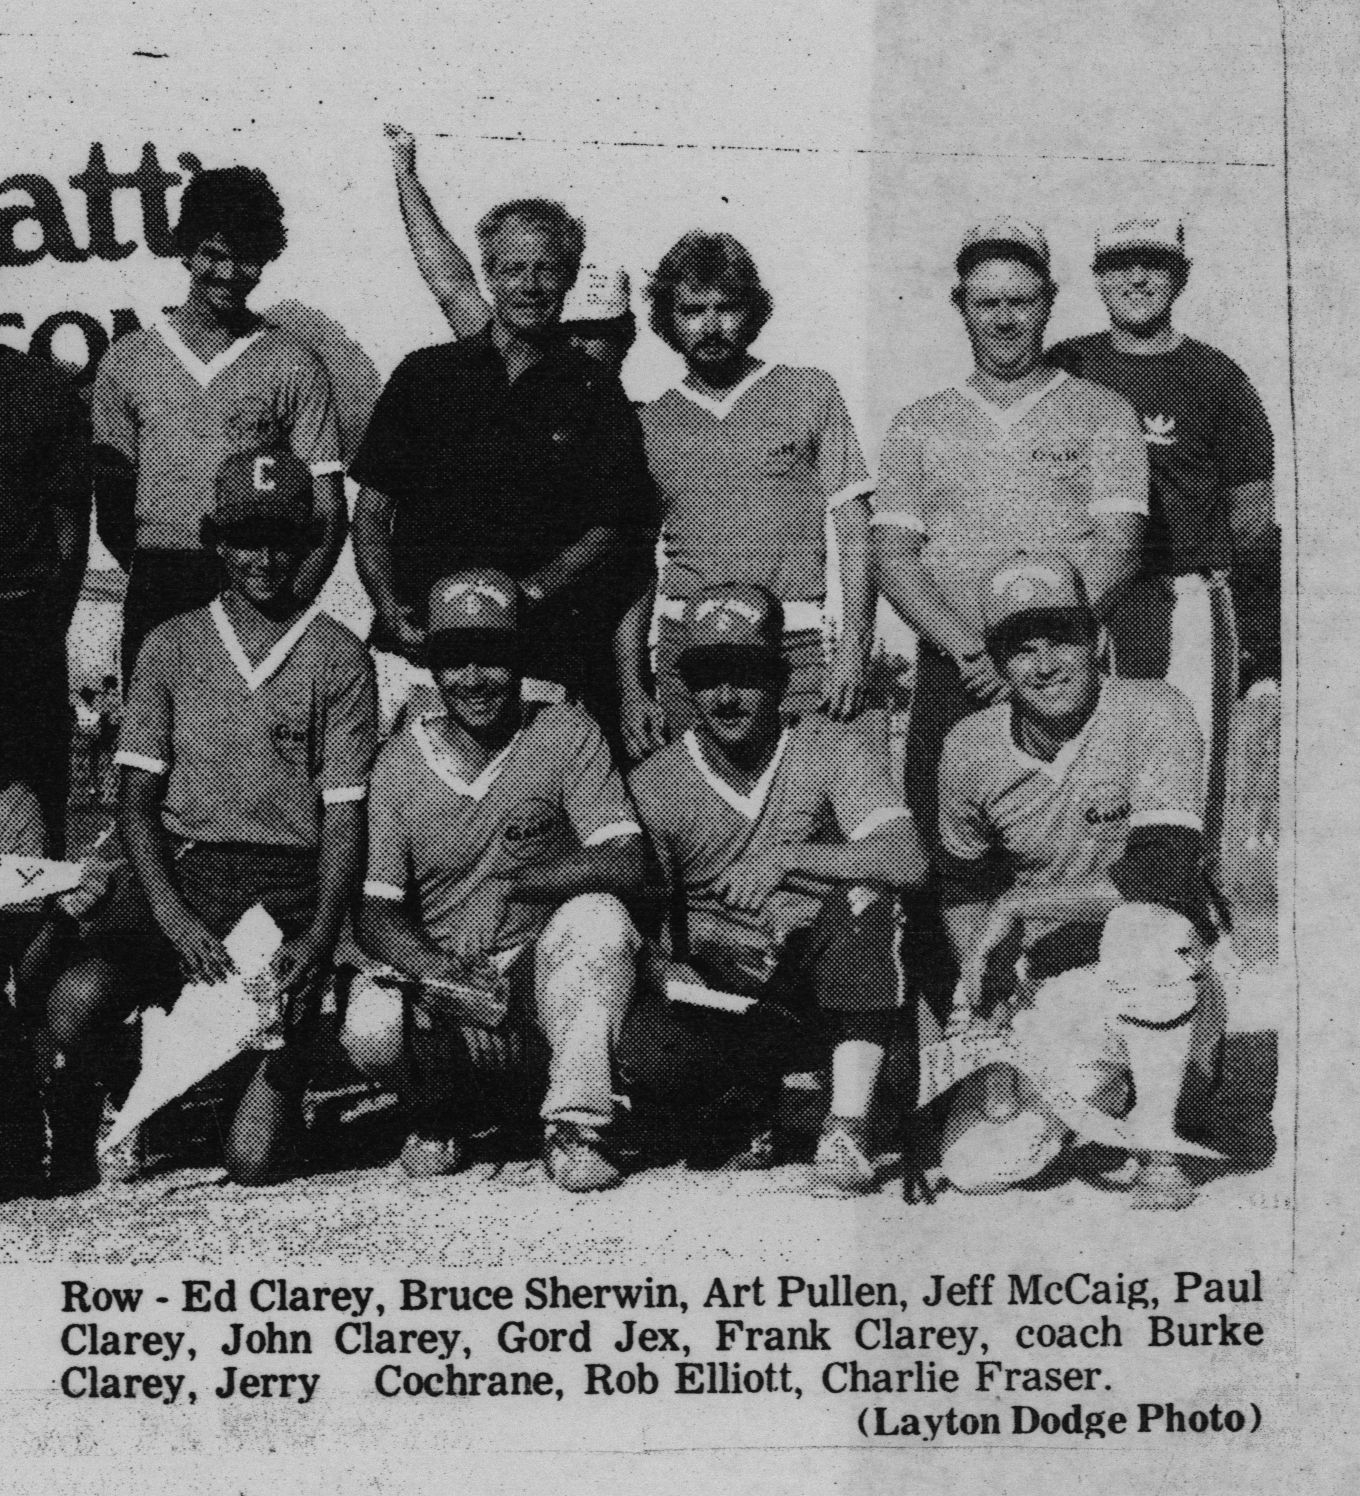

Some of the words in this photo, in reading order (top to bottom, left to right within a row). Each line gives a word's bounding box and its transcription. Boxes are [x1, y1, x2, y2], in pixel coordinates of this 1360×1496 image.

[253, 456, 276, 490] C
[60, 1280, 144, 1313] Row
[181, 1278, 238, 1313] Ed
[249, 1278, 385, 1318] Clarey,
[399, 1278, 514, 1312] Bruce
[525, 1275, 689, 1314] Sherwin,
[702, 1276, 766, 1308] Art
[777, 1273, 908, 1313] Pullen,
[922, 1273, 996, 1307] Jeff
[1007, 1272, 1159, 1311] McCaig,
[1173, 1269, 1264, 1304] Paul
[60, 1322, 197, 1362] Clarey,
[221, 1321, 313, 1356] John
[334, 1321, 472, 1361] Clarey,
[497, 1319, 592, 1354] Gord
[614, 1320, 691, 1358] Jex,
[715, 1318, 832, 1352] Frank
[854, 1317, 989, 1356] Clarey,
[1015, 1314, 1123, 1350] coach
[1147, 1313, 1264, 1347] Burke
[60, 1365, 197, 1406] Clarey,
[215, 1366, 321, 1405] Jerry
[374, 1363, 564, 1402] Cochrane,
[583, 1361, 659, 1396] Rob
[674, 1361, 803, 1400] Elliott,
[821, 1359, 960, 1394] Charlie
[975, 1360, 1113, 1392] Fraser.
[857, 1406, 1001, 1442] (Layton
[1010, 1403, 1128, 1440] Dodge
[1136, 1402, 1262, 1434] Photo)
